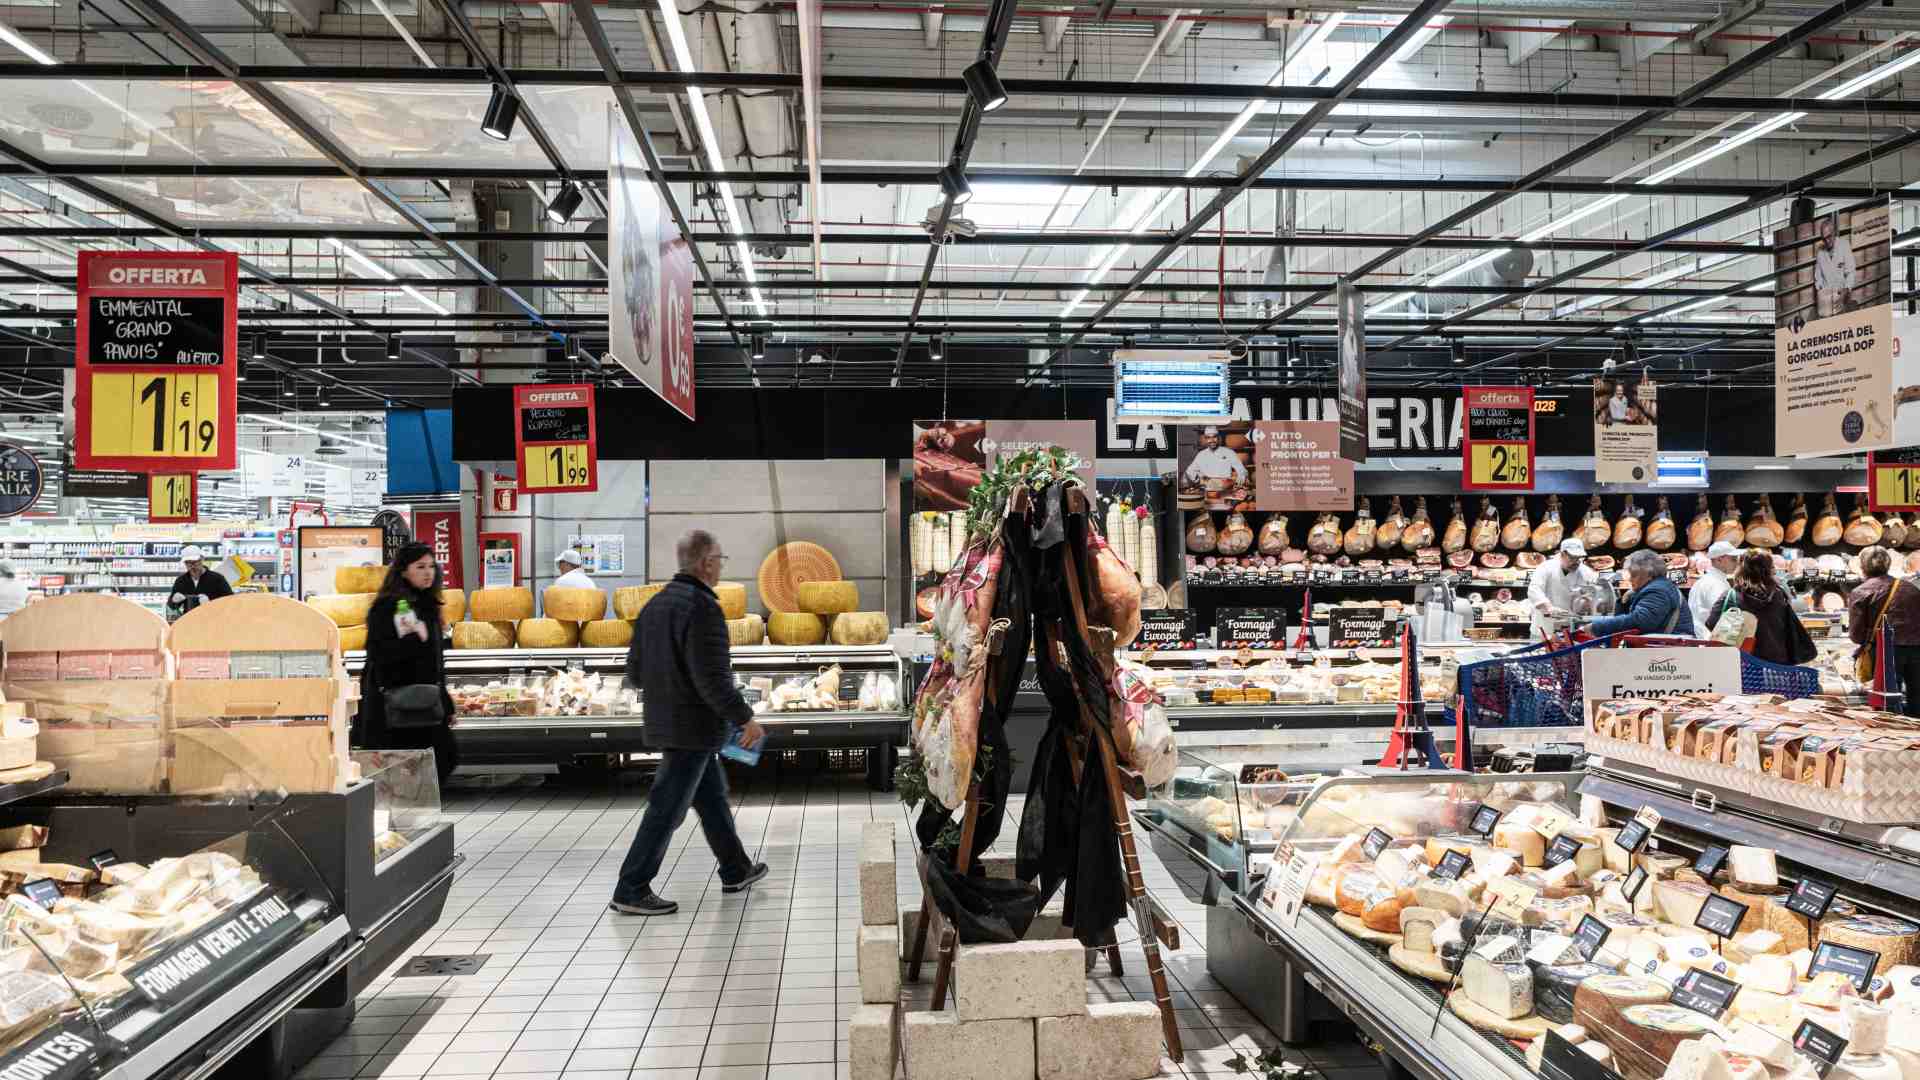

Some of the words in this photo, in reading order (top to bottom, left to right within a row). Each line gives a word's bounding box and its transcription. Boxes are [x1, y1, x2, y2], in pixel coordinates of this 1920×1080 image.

[108, 267, 207, 284] OFFERTA
[99, 300, 192, 317] EMMENTAL
[1787, 341, 1799, 352] LA
[1800, 326, 1854, 349] CREMOSITÀ
[1856, 325, 1875, 337] DEL
[1787, 344, 1852, 365] GORGONZOLA
[1853, 339, 1875, 352] DOP
[180, 392, 191, 407] €
[529, 392, 578, 402] OFFERTA
[1480, 392, 1520, 404] offerta
[141, 377, 167, 451] 1
[179, 420, 214, 451] 19
[1270, 432, 1302, 440] TUTTO
[1281, 441, 1318, 449] MEGLIO
[1271, 450, 1310, 459] PRONTO
[287, 457, 301, 468] 24
[550, 447, 564, 484] 1
[568, 467, 587, 483] 99
[1491, 446, 1508, 482] 2
[1510, 466, 1527, 482] 79
[366, 471, 377, 481] 22
[1226, 619, 1276, 632] Formaggi
[1339, 619, 1386, 632] Formaggi
[1232, 630, 1271, 642] Europei
[1344, 630, 1381, 642] Europei
[1648, 661, 1677, 675] disalp
[135, 944, 211, 1000] FORMAGGI
[198, 918, 253, 959] VENETI
[239, 913, 261, 935] E
[250, 895, 291, 928] FRIULI
